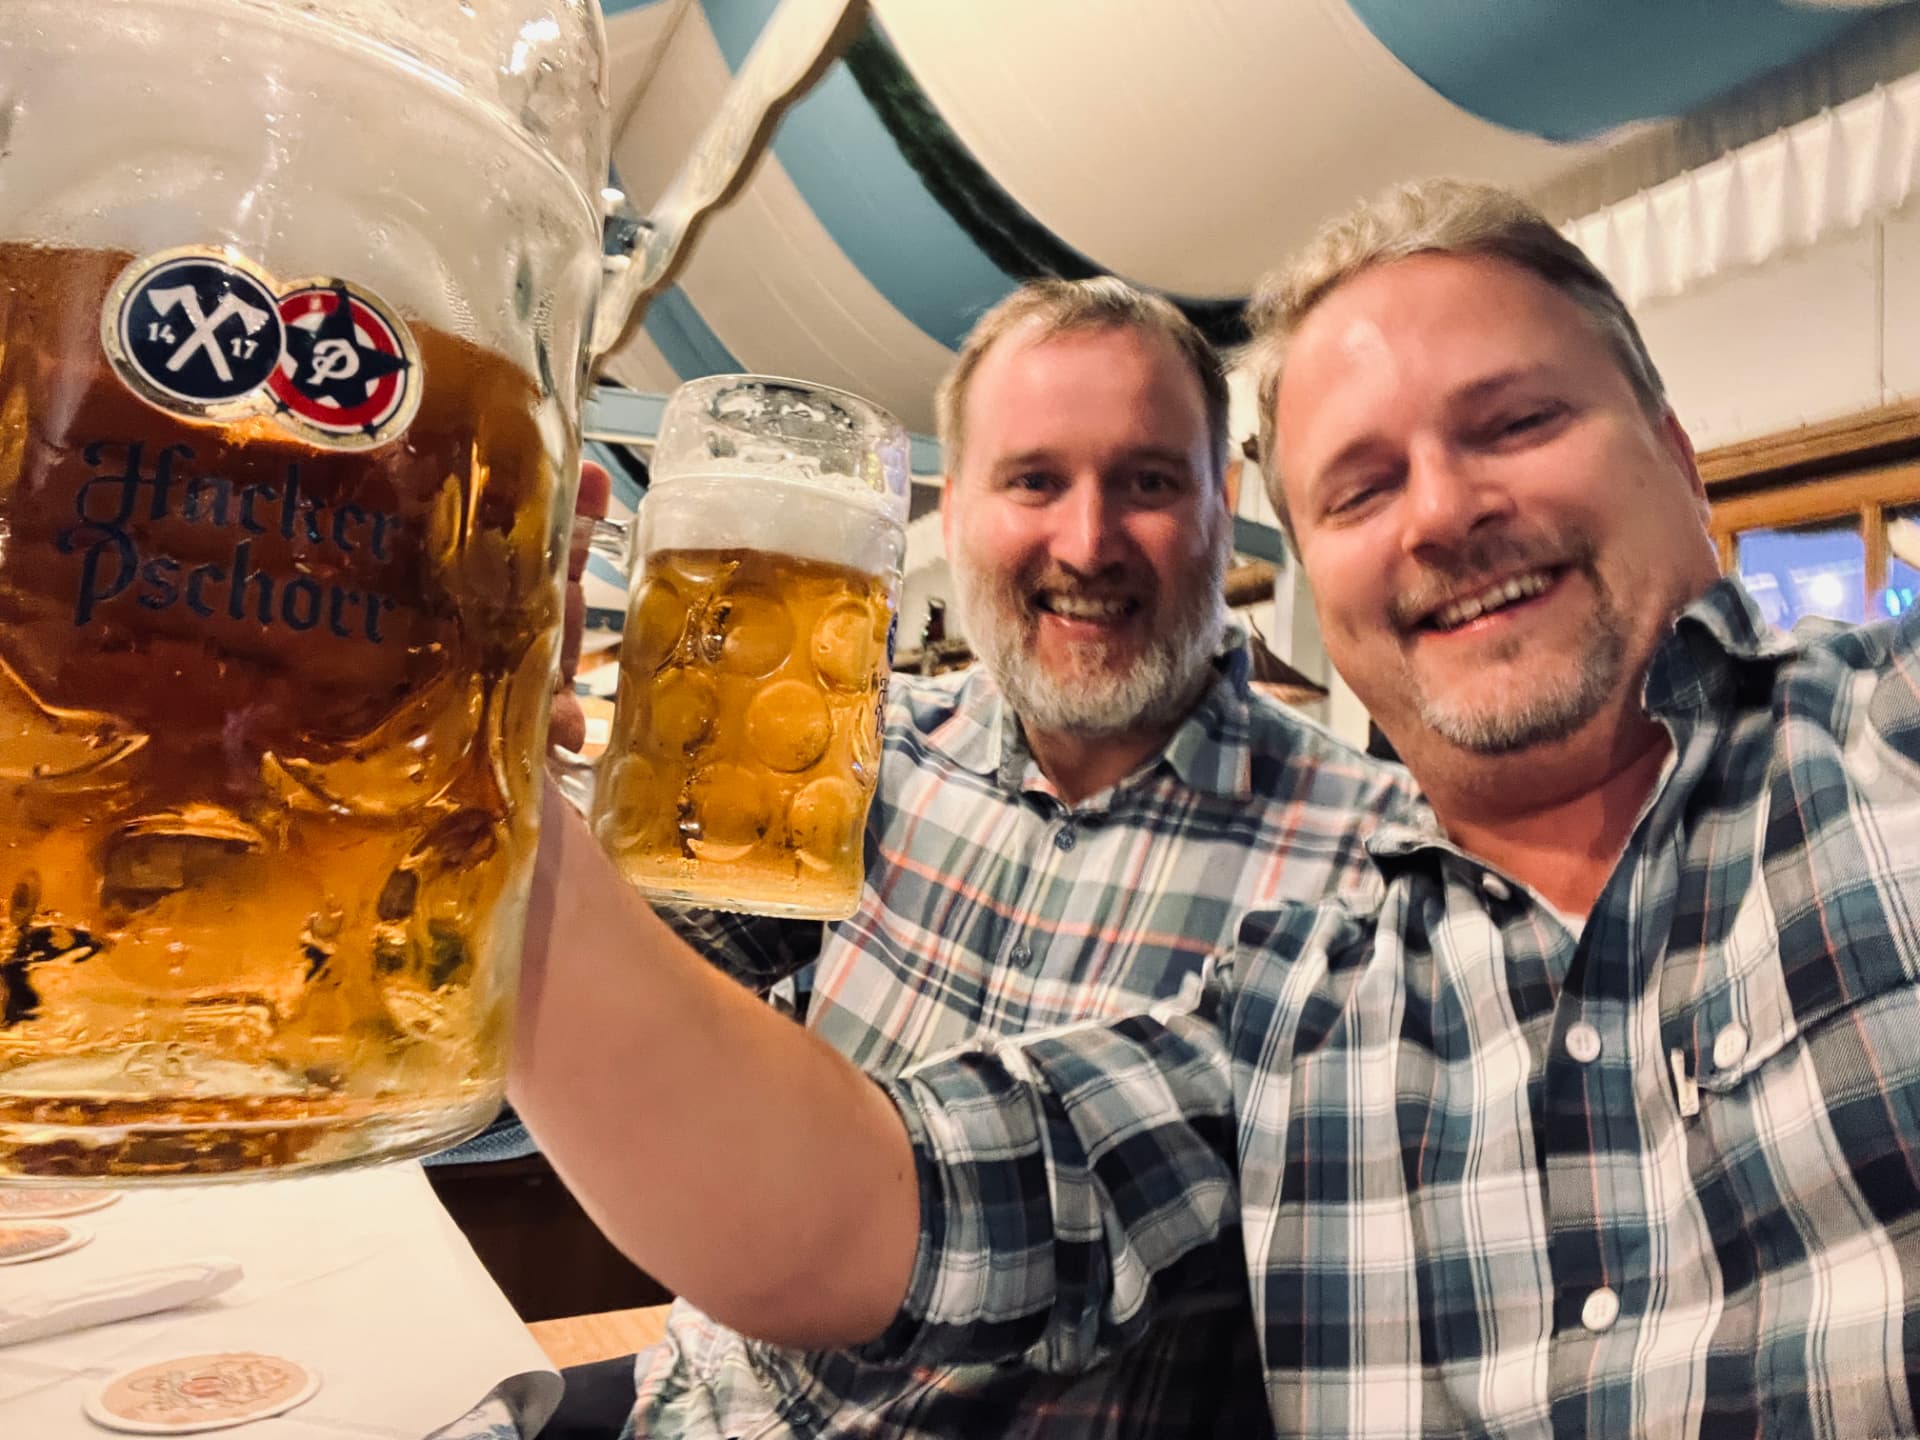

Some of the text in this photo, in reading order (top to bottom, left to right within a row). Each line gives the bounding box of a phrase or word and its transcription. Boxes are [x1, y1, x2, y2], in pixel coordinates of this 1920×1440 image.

[147, 321, 260, 360] 14 17
[76, 440, 401, 560] Hacker
[56, 523, 396, 644] Pschorr
